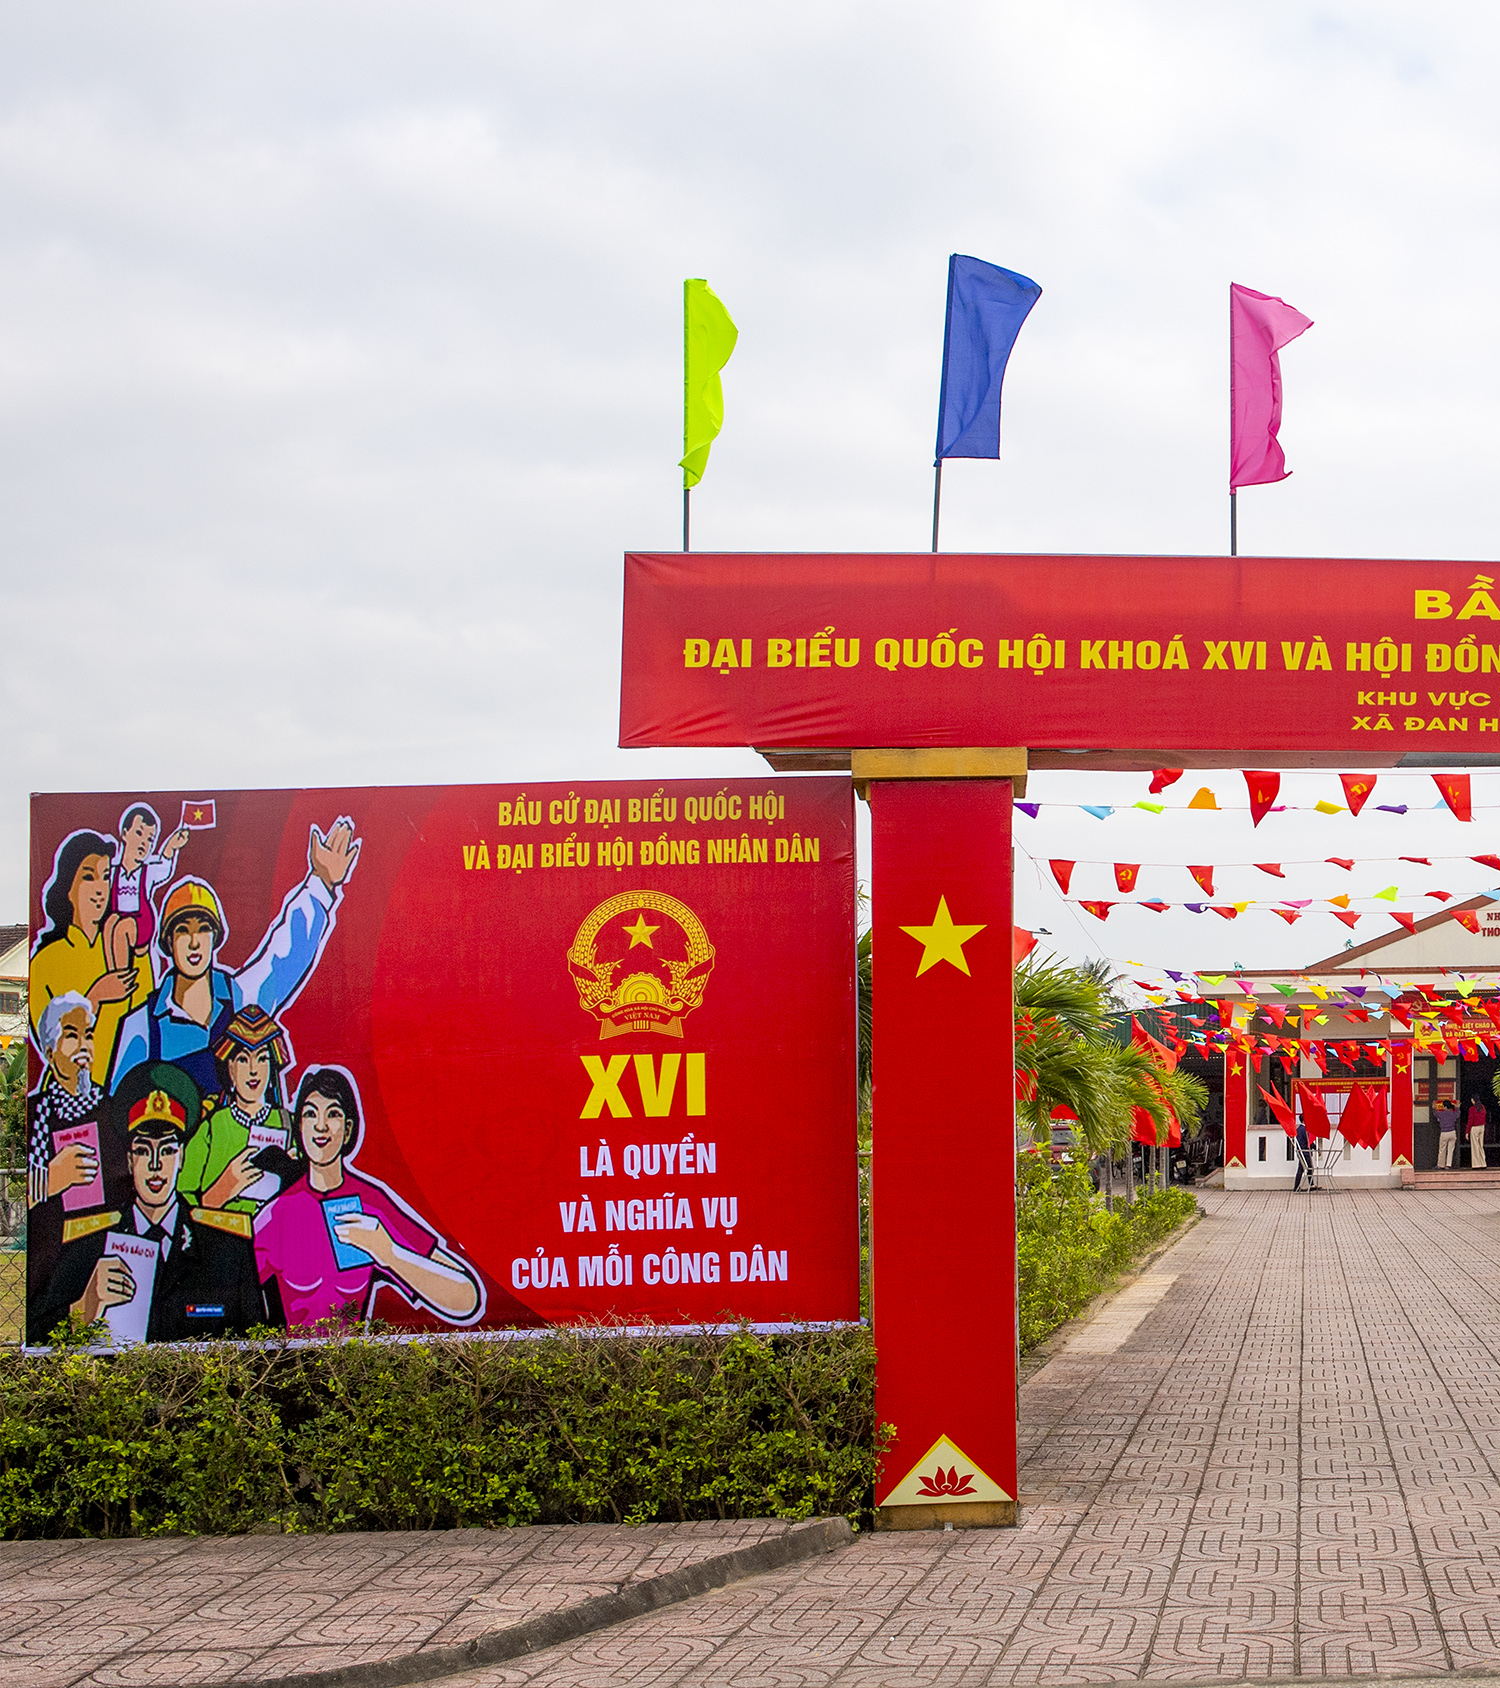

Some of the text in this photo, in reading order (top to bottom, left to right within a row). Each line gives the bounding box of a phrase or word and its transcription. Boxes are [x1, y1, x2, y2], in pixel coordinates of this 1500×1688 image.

[683, 639, 752, 674] ĐẠI
[767, 626, 860, 668] BIỂU
[875, 628, 983, 671] QUỐC
[999, 633, 1065, 676] HỘI
[1081, 634, 1189, 671] KHOÁ
[1203, 641, 1266, 671] XVI
[1281, 636, 1332, 671] VÀ
[1346, 637, 1411, 678] HỘI
[1357, 691, 1417, 706] KHU
[1428, 690, 1491, 710] VỰC
[1352, 714, 1394, 731] XÃ
[1404, 716, 1469, 732] ĐAN
[498, 787, 785, 829] BẦU CỬ ĐẠI BIỂU QUỐC HỘI
[463, 831, 820, 874] VÀ ĐẠI BIỂU HỘI ĐỒNG NHÂN DÂN
[624, 1011, 660, 1020] VIỆT NAM
[579, 1052, 707, 1119] XVI
[579, 1133, 717, 1179] LÀ QUYỀN
[559, 1192, 738, 1235] VÀ NGHĨA VỤ
[511, 1243, 788, 1290] CỦA MỖI CÔNG DÂN
